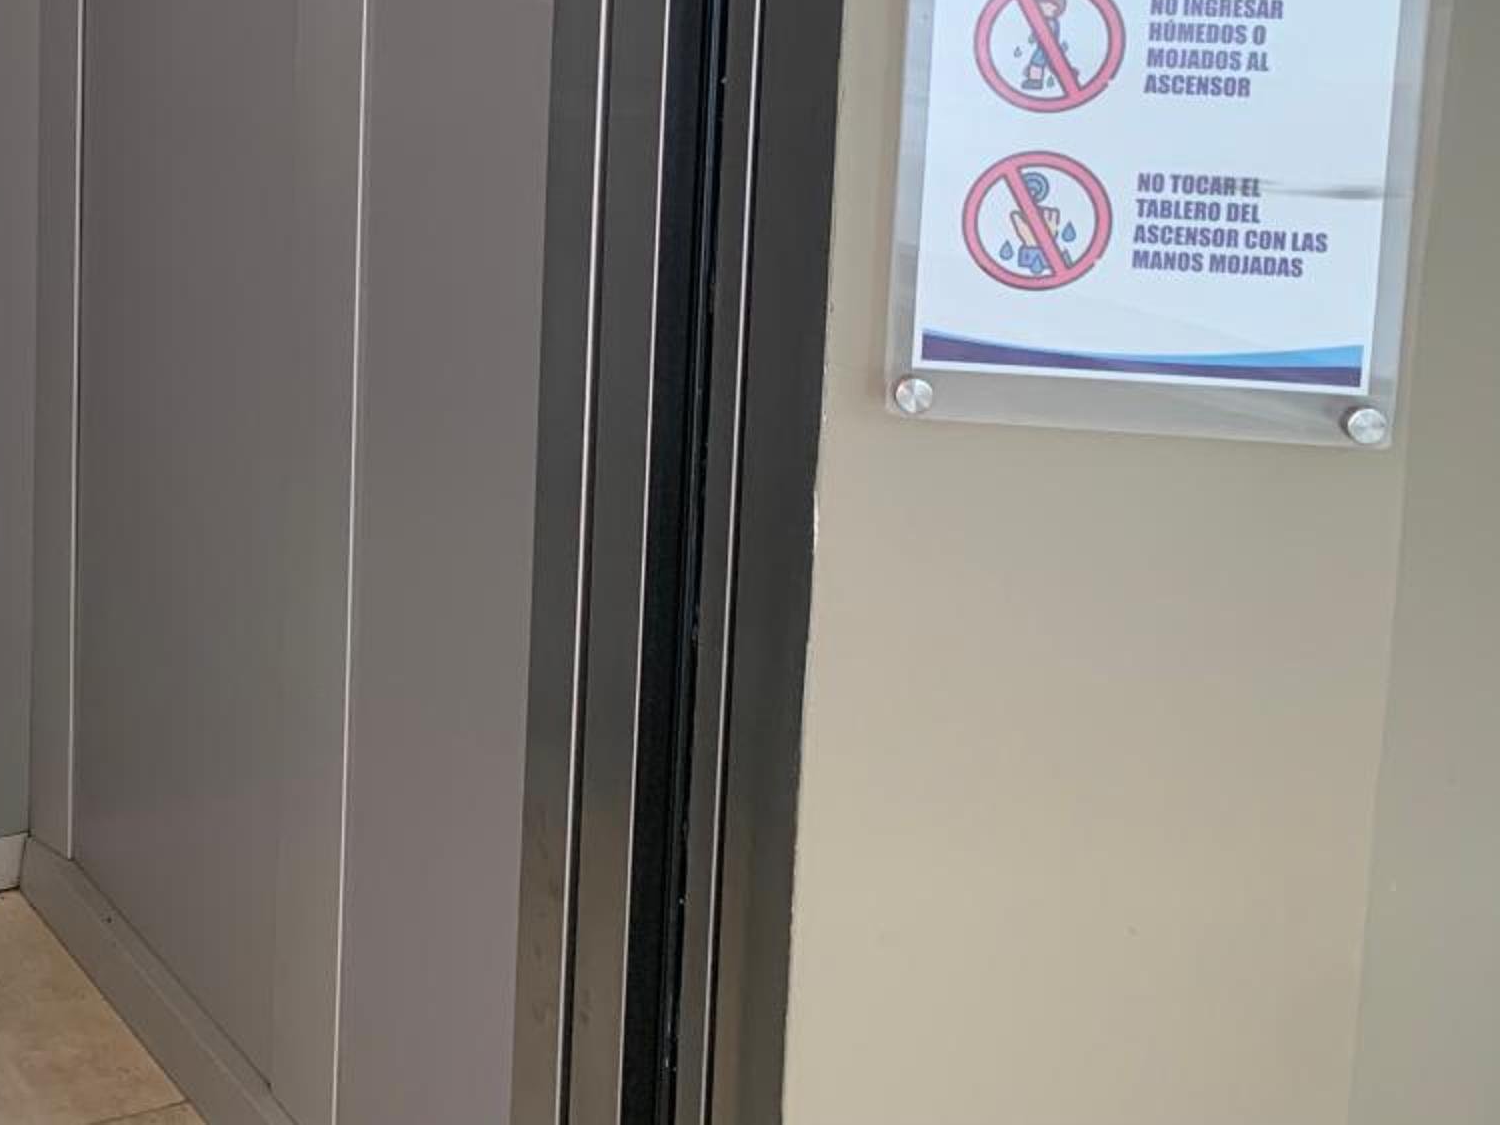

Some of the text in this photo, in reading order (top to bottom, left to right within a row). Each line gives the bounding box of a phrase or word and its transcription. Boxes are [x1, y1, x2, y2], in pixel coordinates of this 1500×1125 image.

[1148, 19, 1267, 45] HÚMEDOS O
[1146, 47, 1269, 72] MOJADOS AL
[1143, 74, 1251, 97] ASCENSOR
[1137, 173, 1261, 197] NO TOCAR EL
[1135, 198, 1261, 224] TABLERO DEL
[1133, 225, 1328, 253] ASCENSOR CON LAS
[1131, 250, 1304, 278] MANOS MOJADAS
